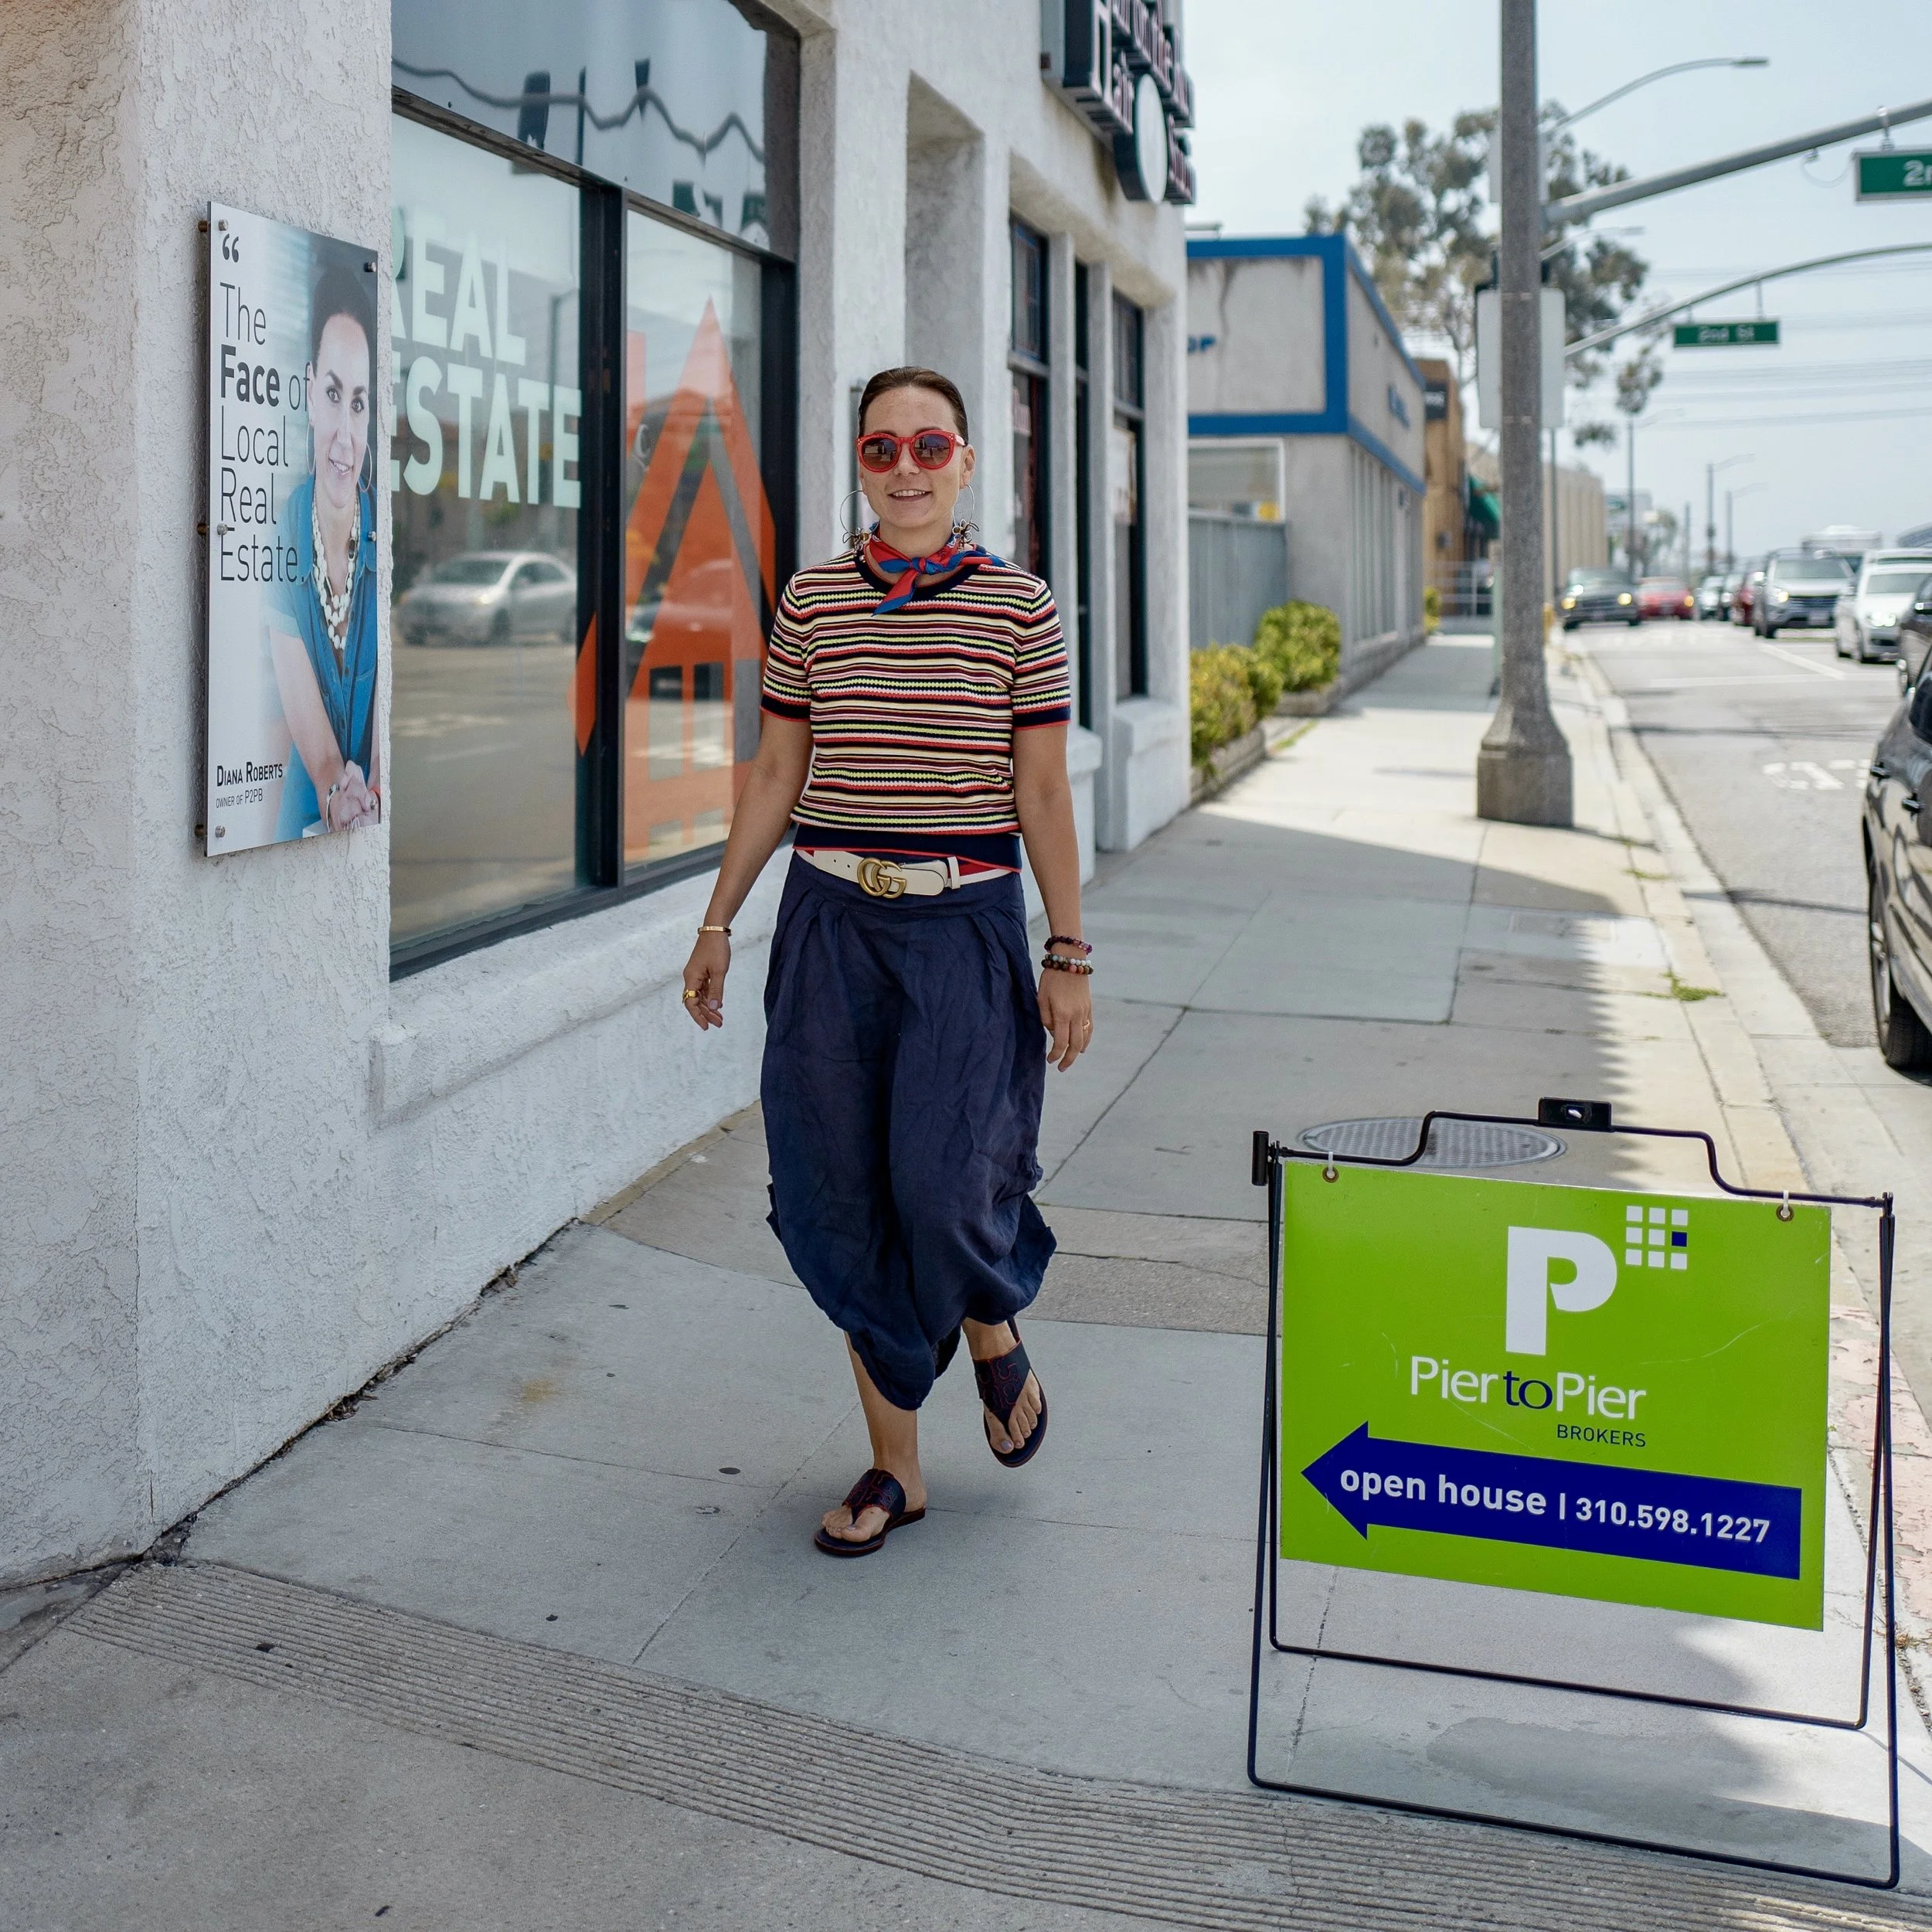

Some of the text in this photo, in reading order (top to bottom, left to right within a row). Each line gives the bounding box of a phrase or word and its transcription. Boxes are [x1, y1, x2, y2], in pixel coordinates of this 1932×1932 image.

[219, 281, 267, 345] The
[220, 344, 311, 412] Face of
[221, 405, 289, 468] Local
[390, 349, 581, 509] STATE
[221, 467, 277, 525] Real
[220, 526, 304, 583] Estate.
[216, 761, 284, 787] DIANA ROBERTS
[216, 788, 264, 808] OWNER OF P2PB
[1556, 1423, 1647, 1448] BROKERS
[1340, 1470, 1426, 1501] open
[1438, 1474, 1546, 1515] house
[1575, 1497, 1770, 1543] 310.598.1227
